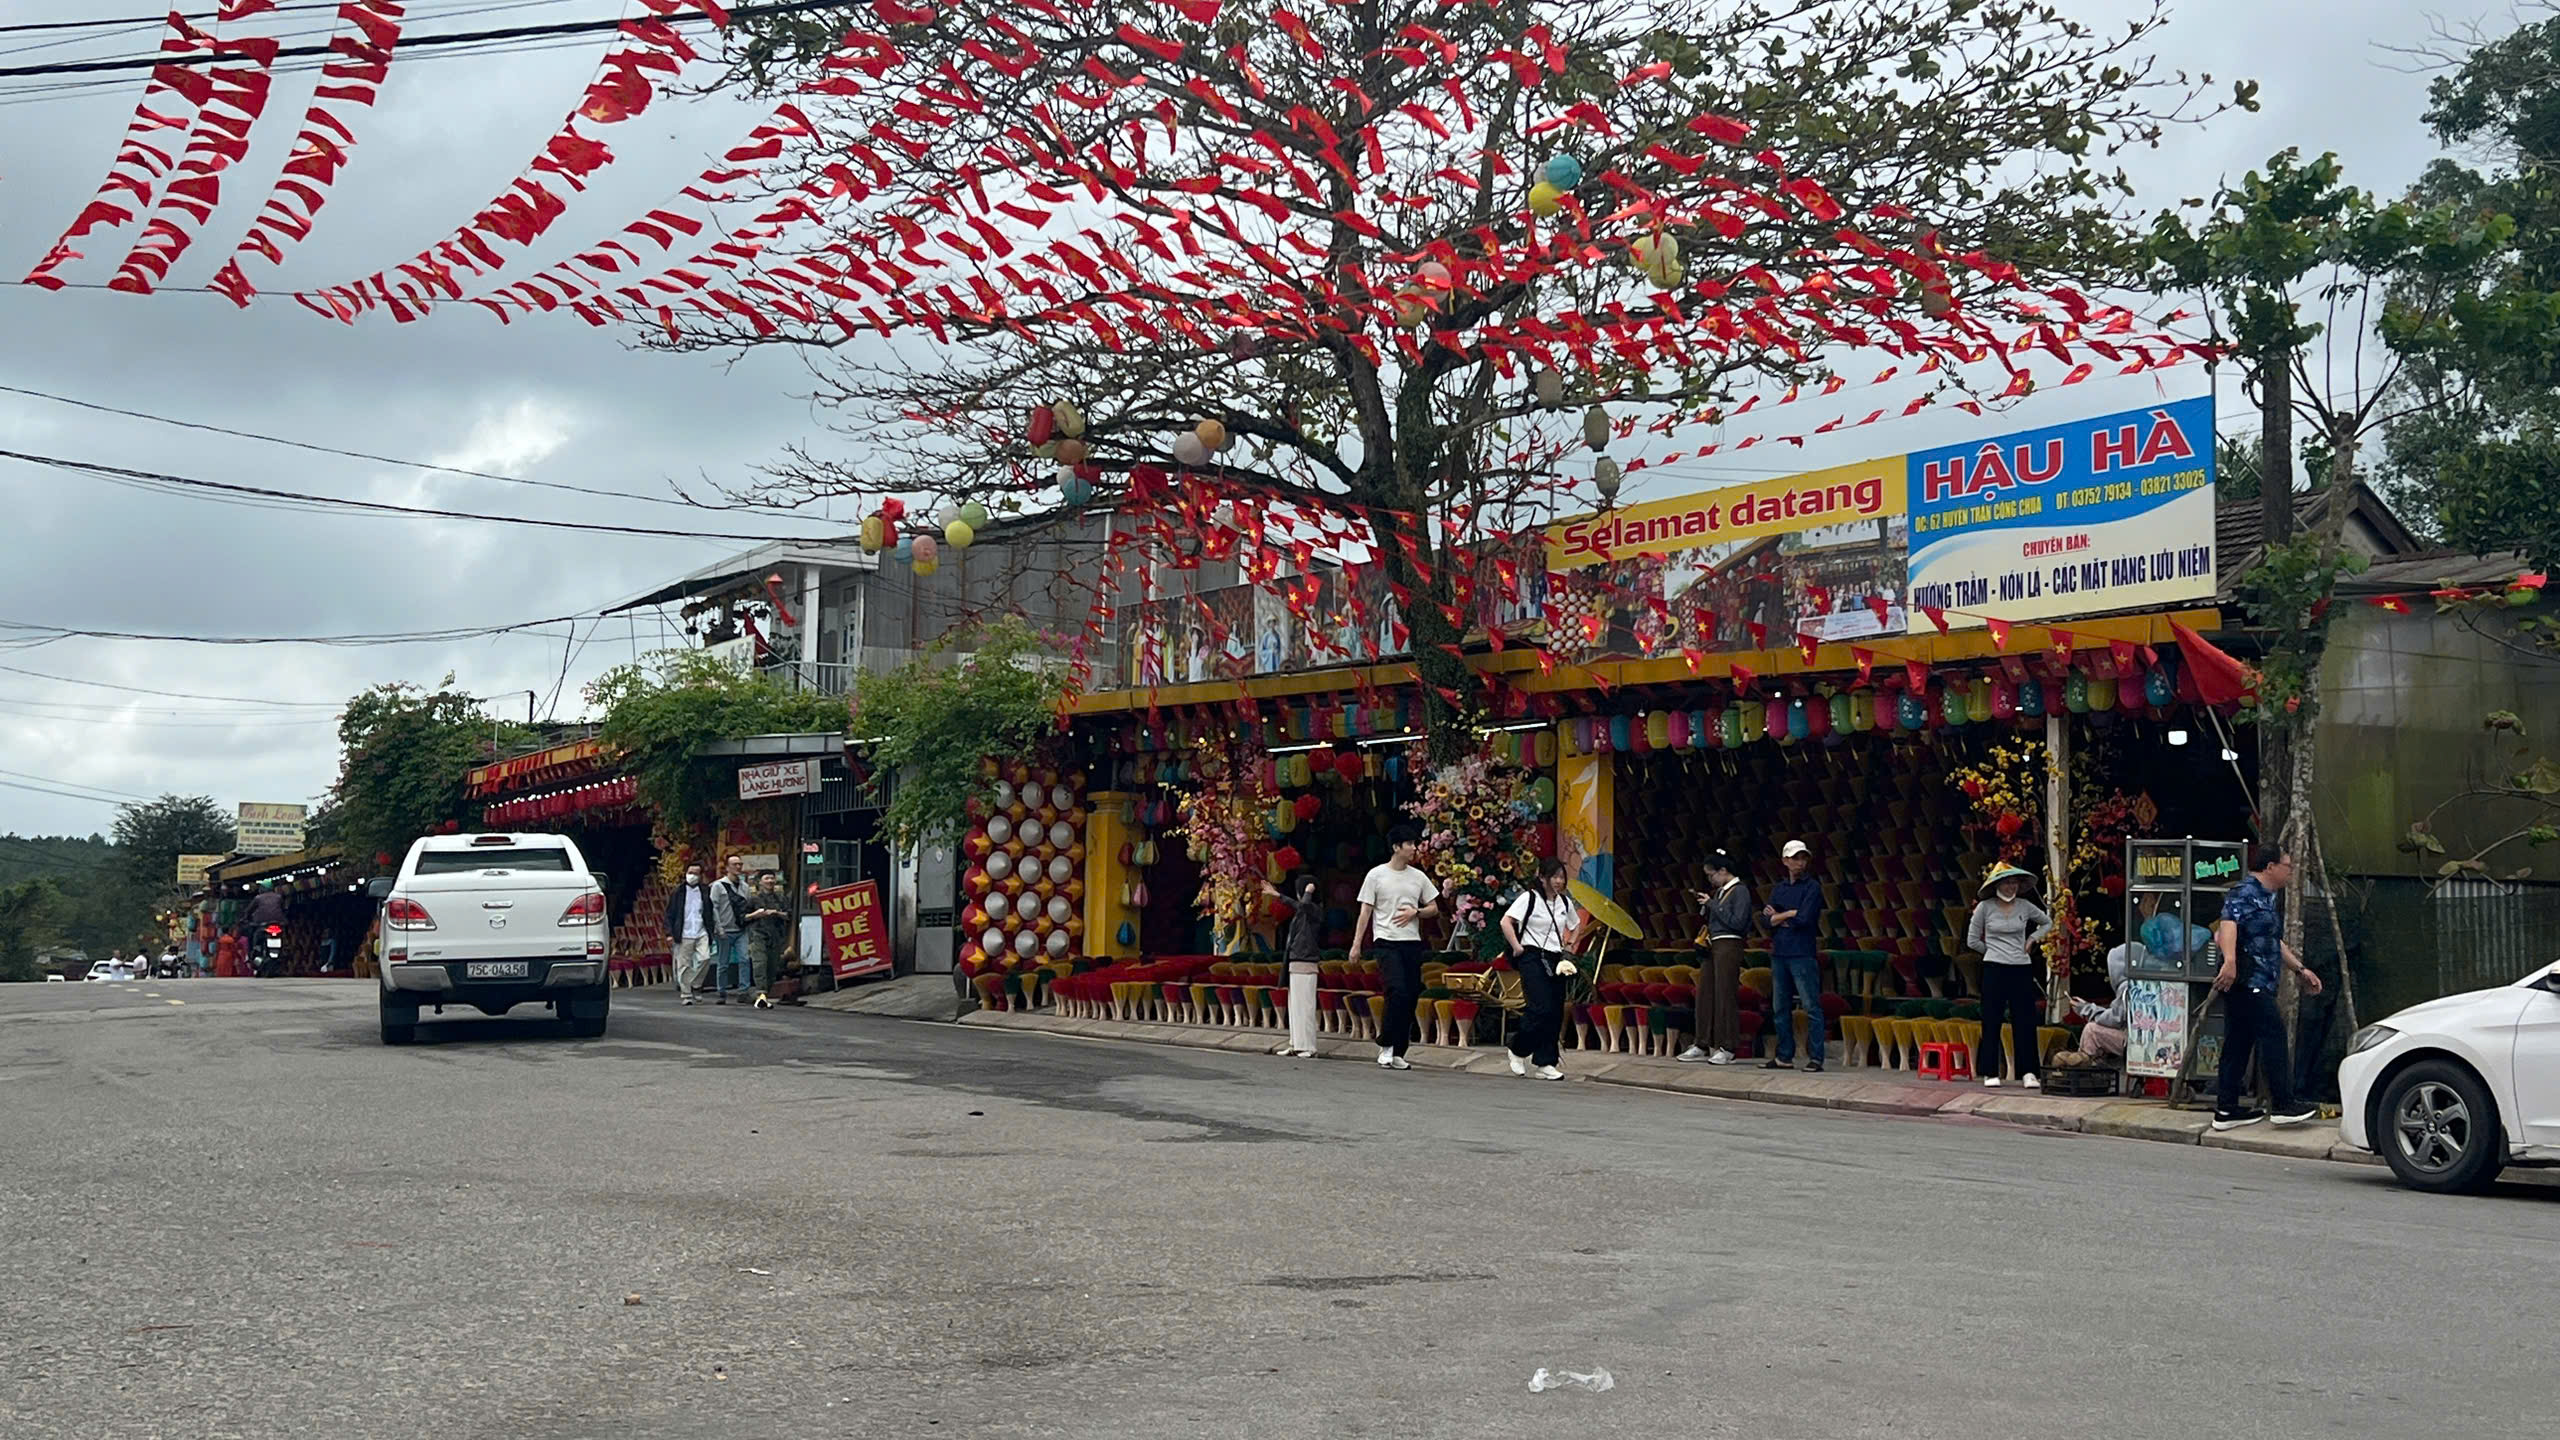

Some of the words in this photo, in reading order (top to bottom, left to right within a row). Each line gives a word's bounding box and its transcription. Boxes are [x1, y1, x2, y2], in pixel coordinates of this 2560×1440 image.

[1924, 438, 2064, 503] HẬU
[2091, 409, 2195, 474] HÀ
[2072, 486, 2101, 507] 03752
[2104, 481, 2132, 502] 79134
[2173, 468, 2206, 489] 33025
[1563, 502, 1720, 555] Selamat
[1730, 478, 1883, 527] datang
[2023, 536, 2063, 557] CHUYÊN
[2066, 533, 2091, 550] BÁN:
[1913, 582, 1951, 613] HƯƠNG
[2000, 569, 2024, 602] NÓN
[2028, 566, 2041, 598] LÁ
[2053, 562, 2077, 595] CÁC
[2081, 558, 2108, 594] MẶT
[2112, 553, 2146, 587] HÀNG
[2150, 548, 2174, 582] LƯU
[2178, 543, 2211, 582] NIỆM
[784, 765, 800, 775] XE
[821, 890, 873, 916] NƠI
[832, 911, 871, 939] ĐỂ
[838, 939, 877, 961] XE
